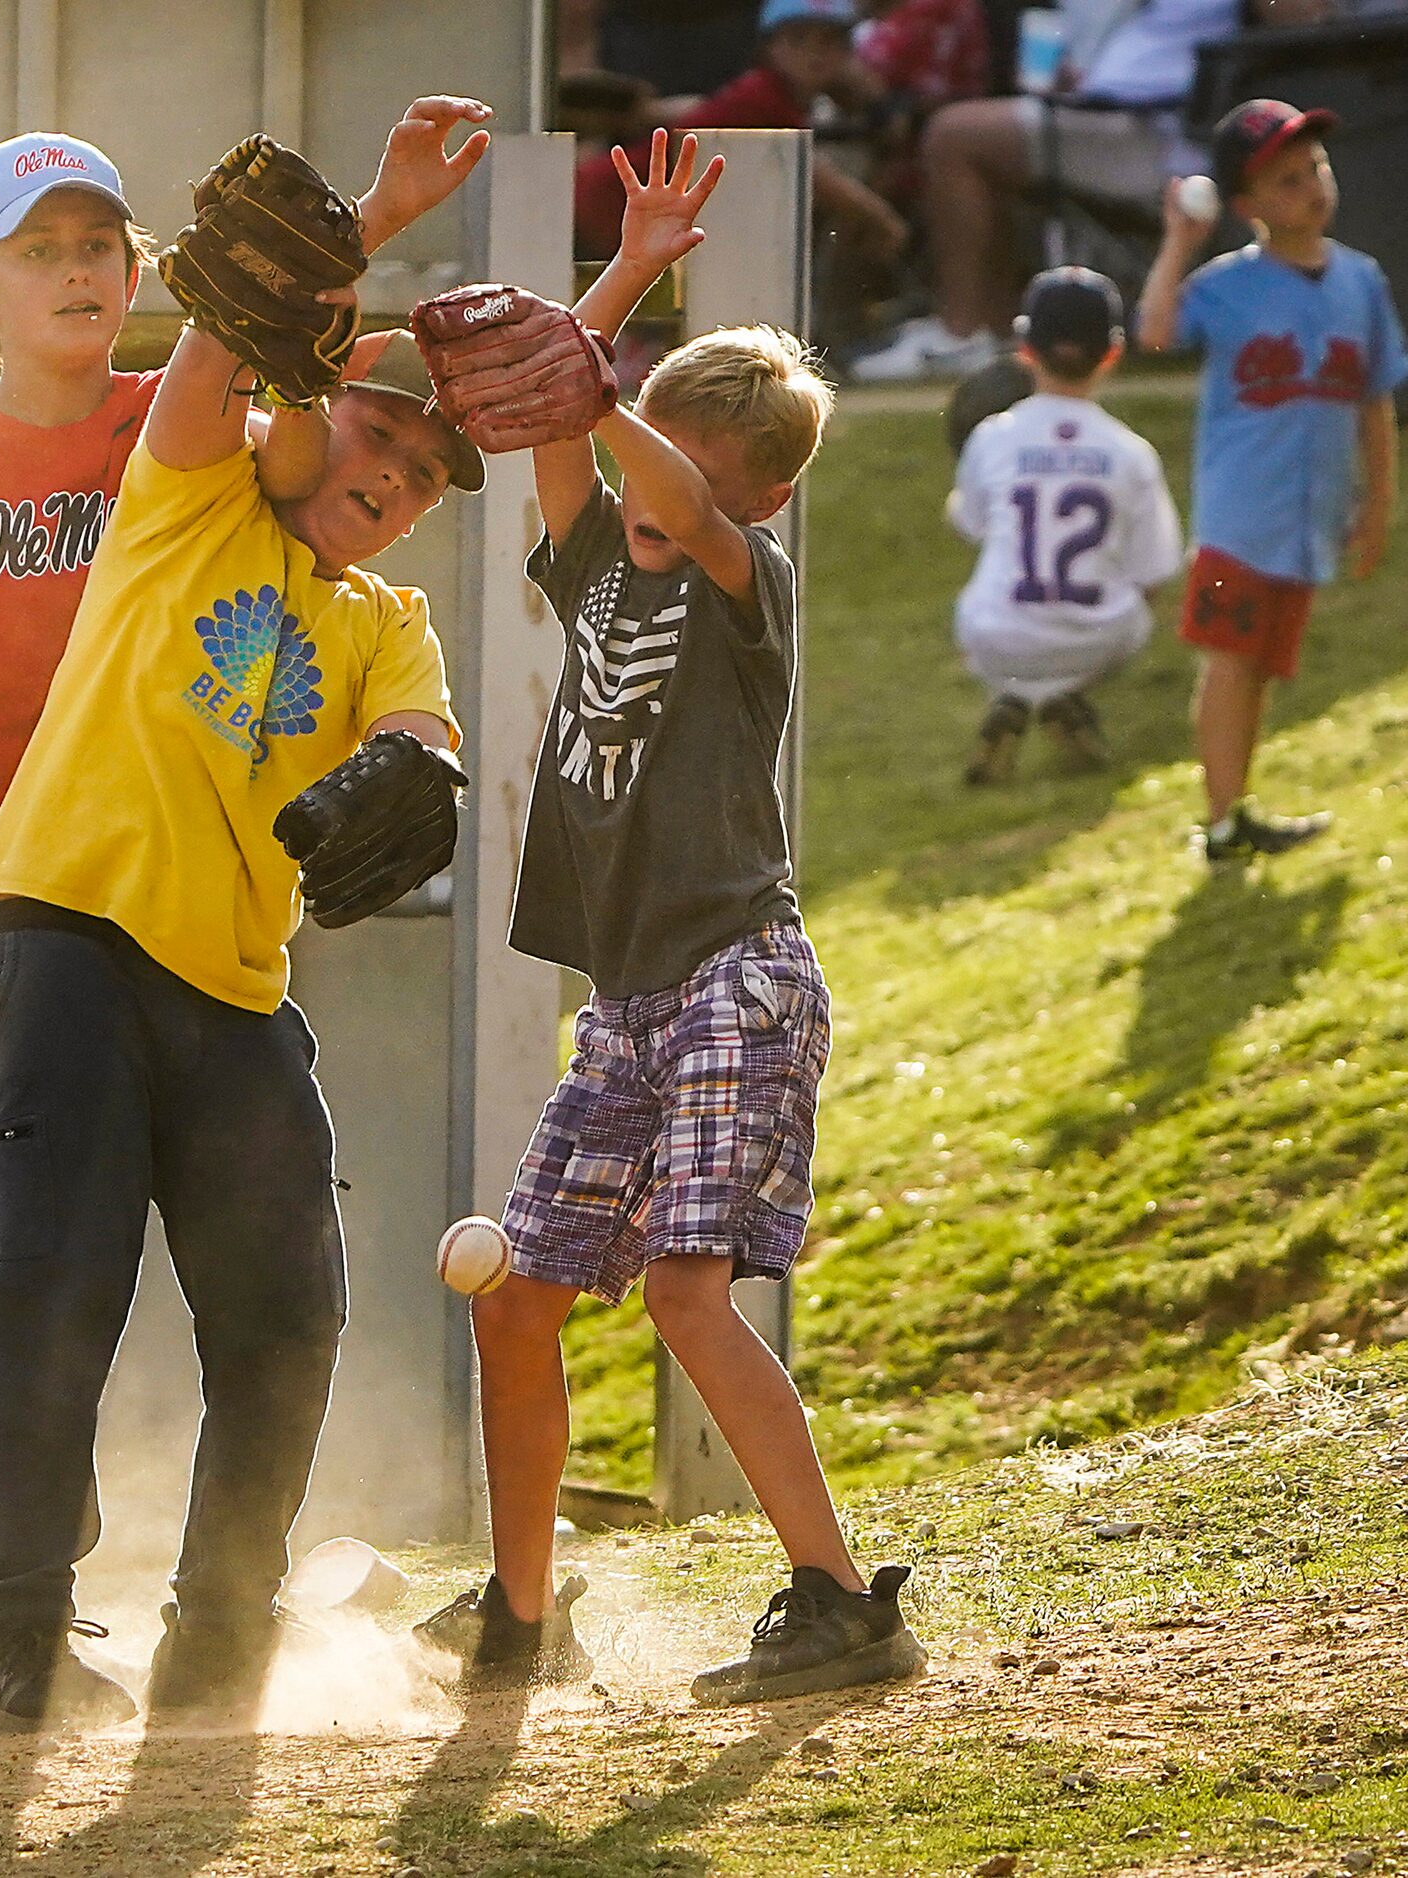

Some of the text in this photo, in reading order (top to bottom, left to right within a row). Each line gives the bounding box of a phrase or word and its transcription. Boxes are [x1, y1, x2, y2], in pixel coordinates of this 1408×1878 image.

[15, 147, 87, 178] Ole Miss
[1010, 482, 1116, 607] 12
[191, 671, 232, 713] BE
